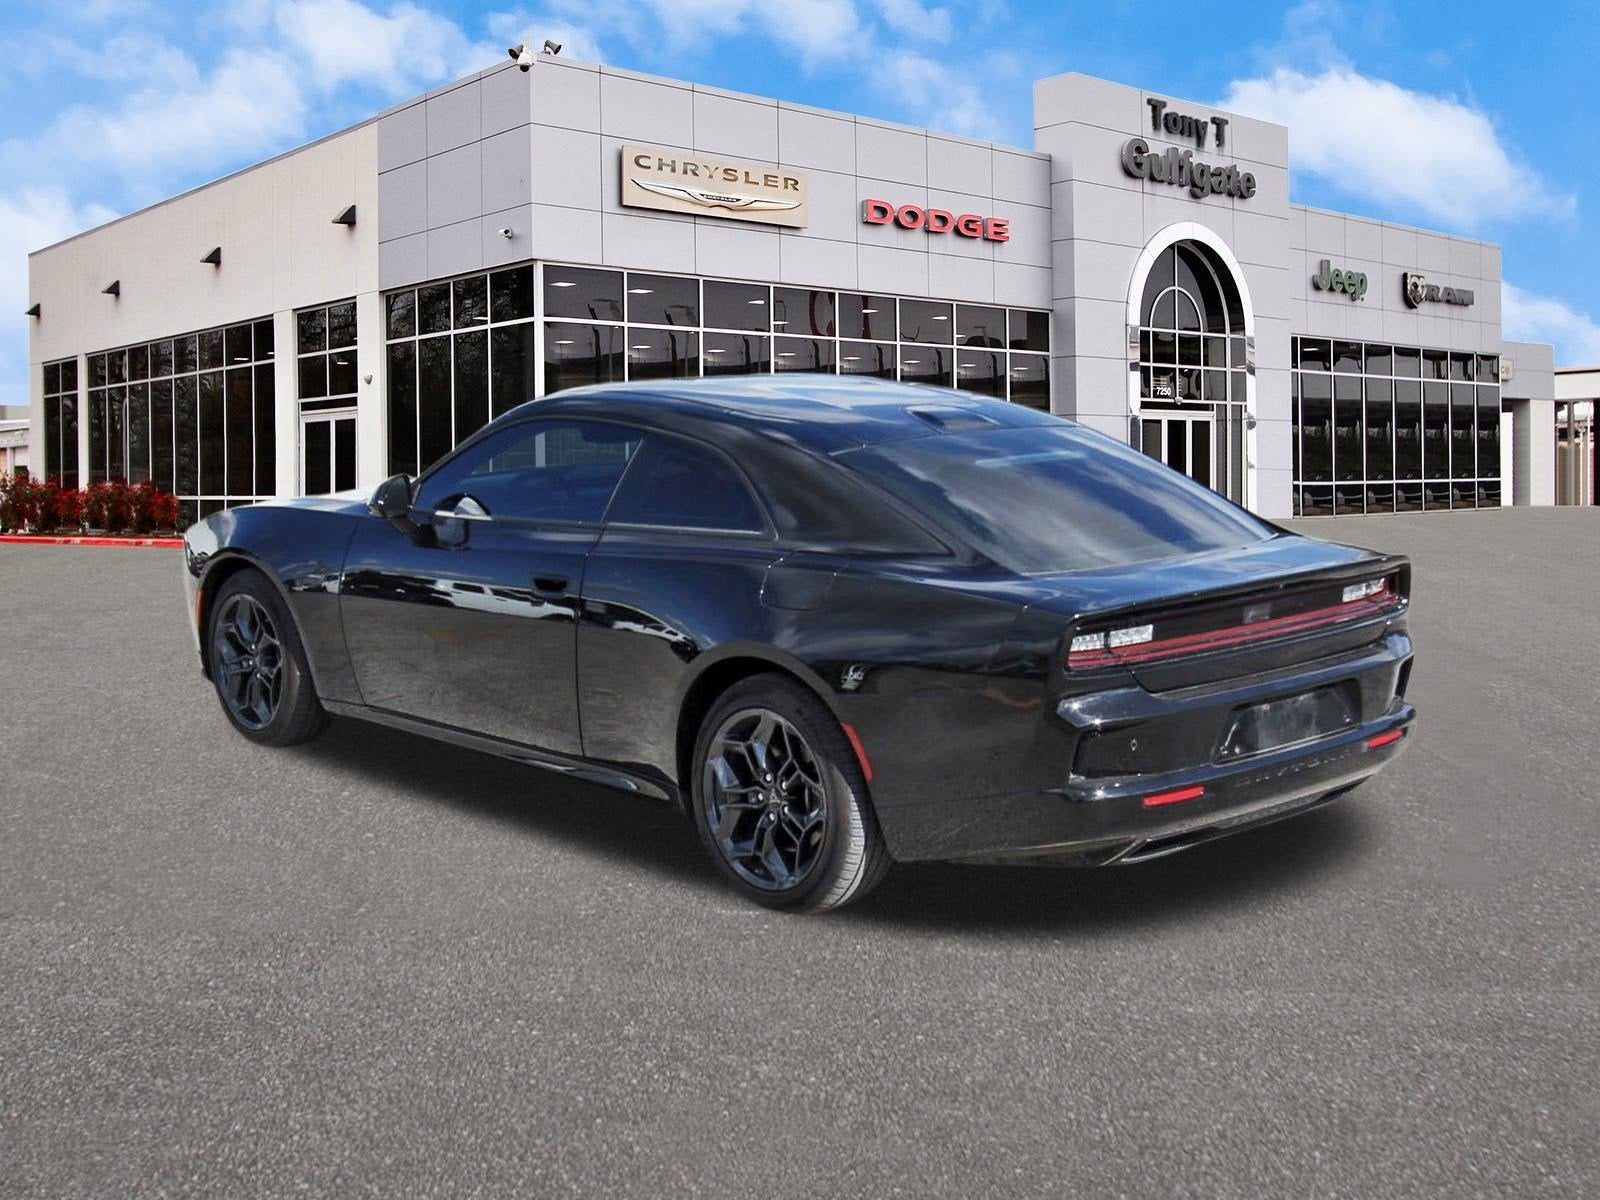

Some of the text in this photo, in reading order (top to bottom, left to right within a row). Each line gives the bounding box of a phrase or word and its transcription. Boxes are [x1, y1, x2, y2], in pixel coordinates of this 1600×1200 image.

[1146, 98, 1229, 147] Tony T
[633, 154, 800, 191] CHRYSLER
[1121, 138, 1257, 199] Gulfgate
[862, 199, 1010, 242] DODGE
[1312, 259, 1368, 302] Jeep
[1424, 284, 1475, 307] RAM
[1156, 386, 1172, 396] 7250
